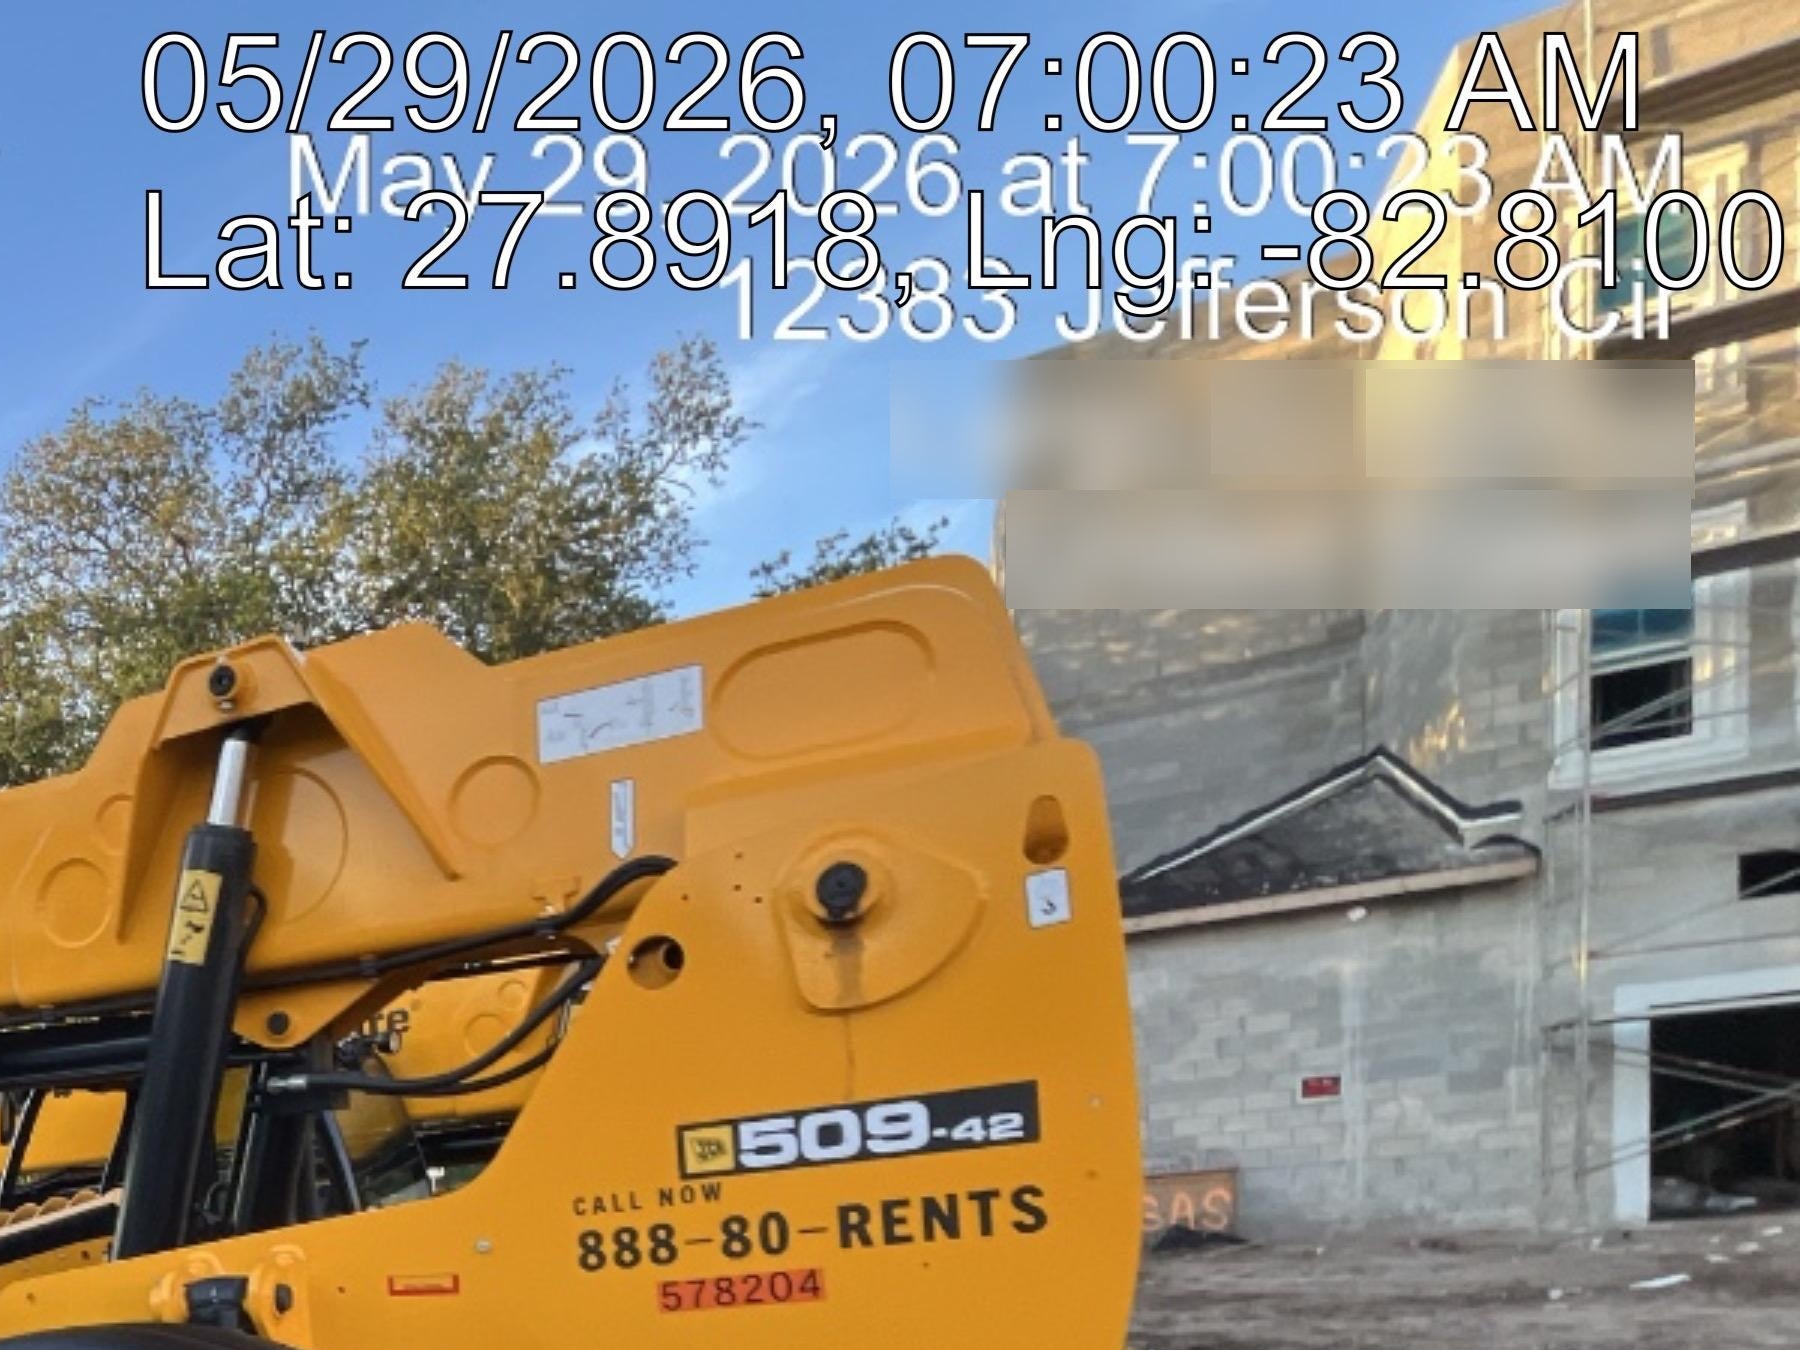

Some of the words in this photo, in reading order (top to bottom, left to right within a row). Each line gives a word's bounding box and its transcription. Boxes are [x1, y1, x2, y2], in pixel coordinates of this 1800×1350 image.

[572, 1191, 643, 1217] CALL
[658, 1182, 722, 1208] NOW
[577, 1184, 1049, 1273] 888-80-RENTS
[660, 1270, 822, 1312] 578204
